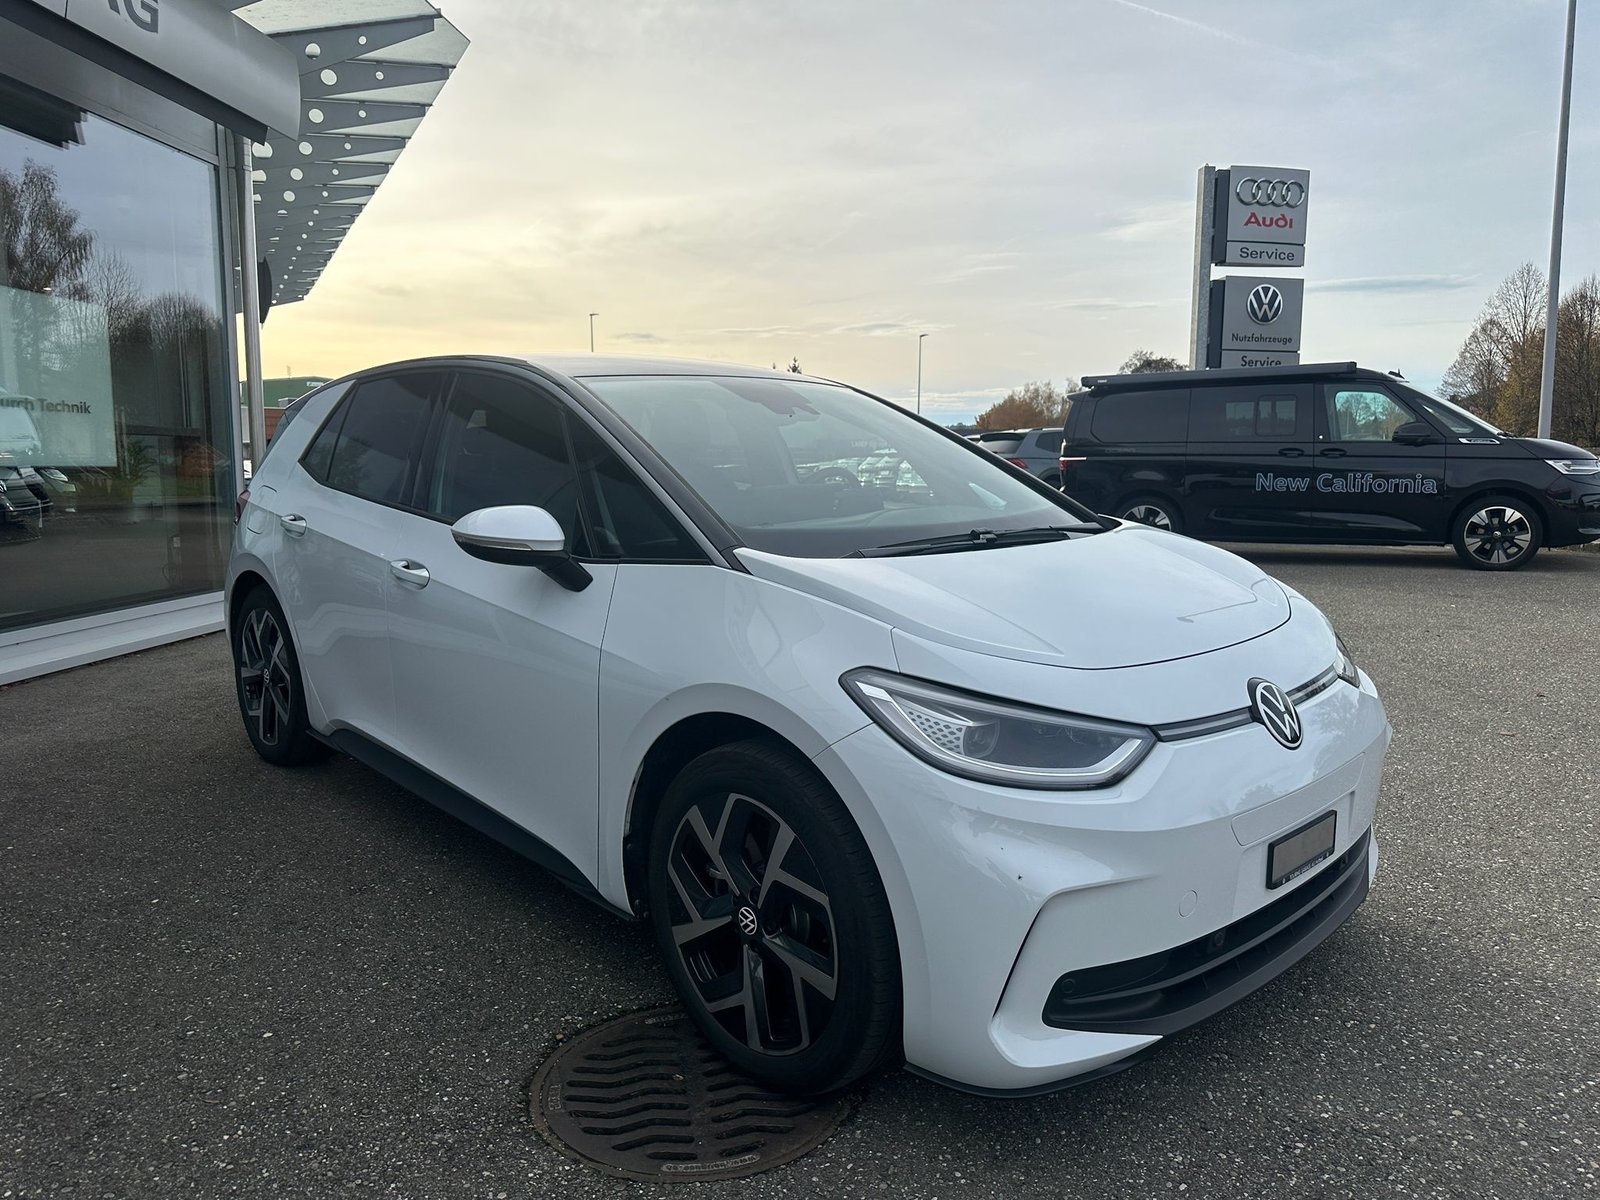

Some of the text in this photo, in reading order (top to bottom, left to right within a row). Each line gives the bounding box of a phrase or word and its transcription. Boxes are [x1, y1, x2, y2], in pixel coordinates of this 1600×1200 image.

[108, 0, 159, 34] G
[1244, 212, 1294, 229] Audi
[1239, 247, 1295, 261] Service
[1231, 333, 1293, 346] Nutzfahrzeuge
[38, 398, 91, 414] Technik
[1255, 472, 1438, 494] New California
